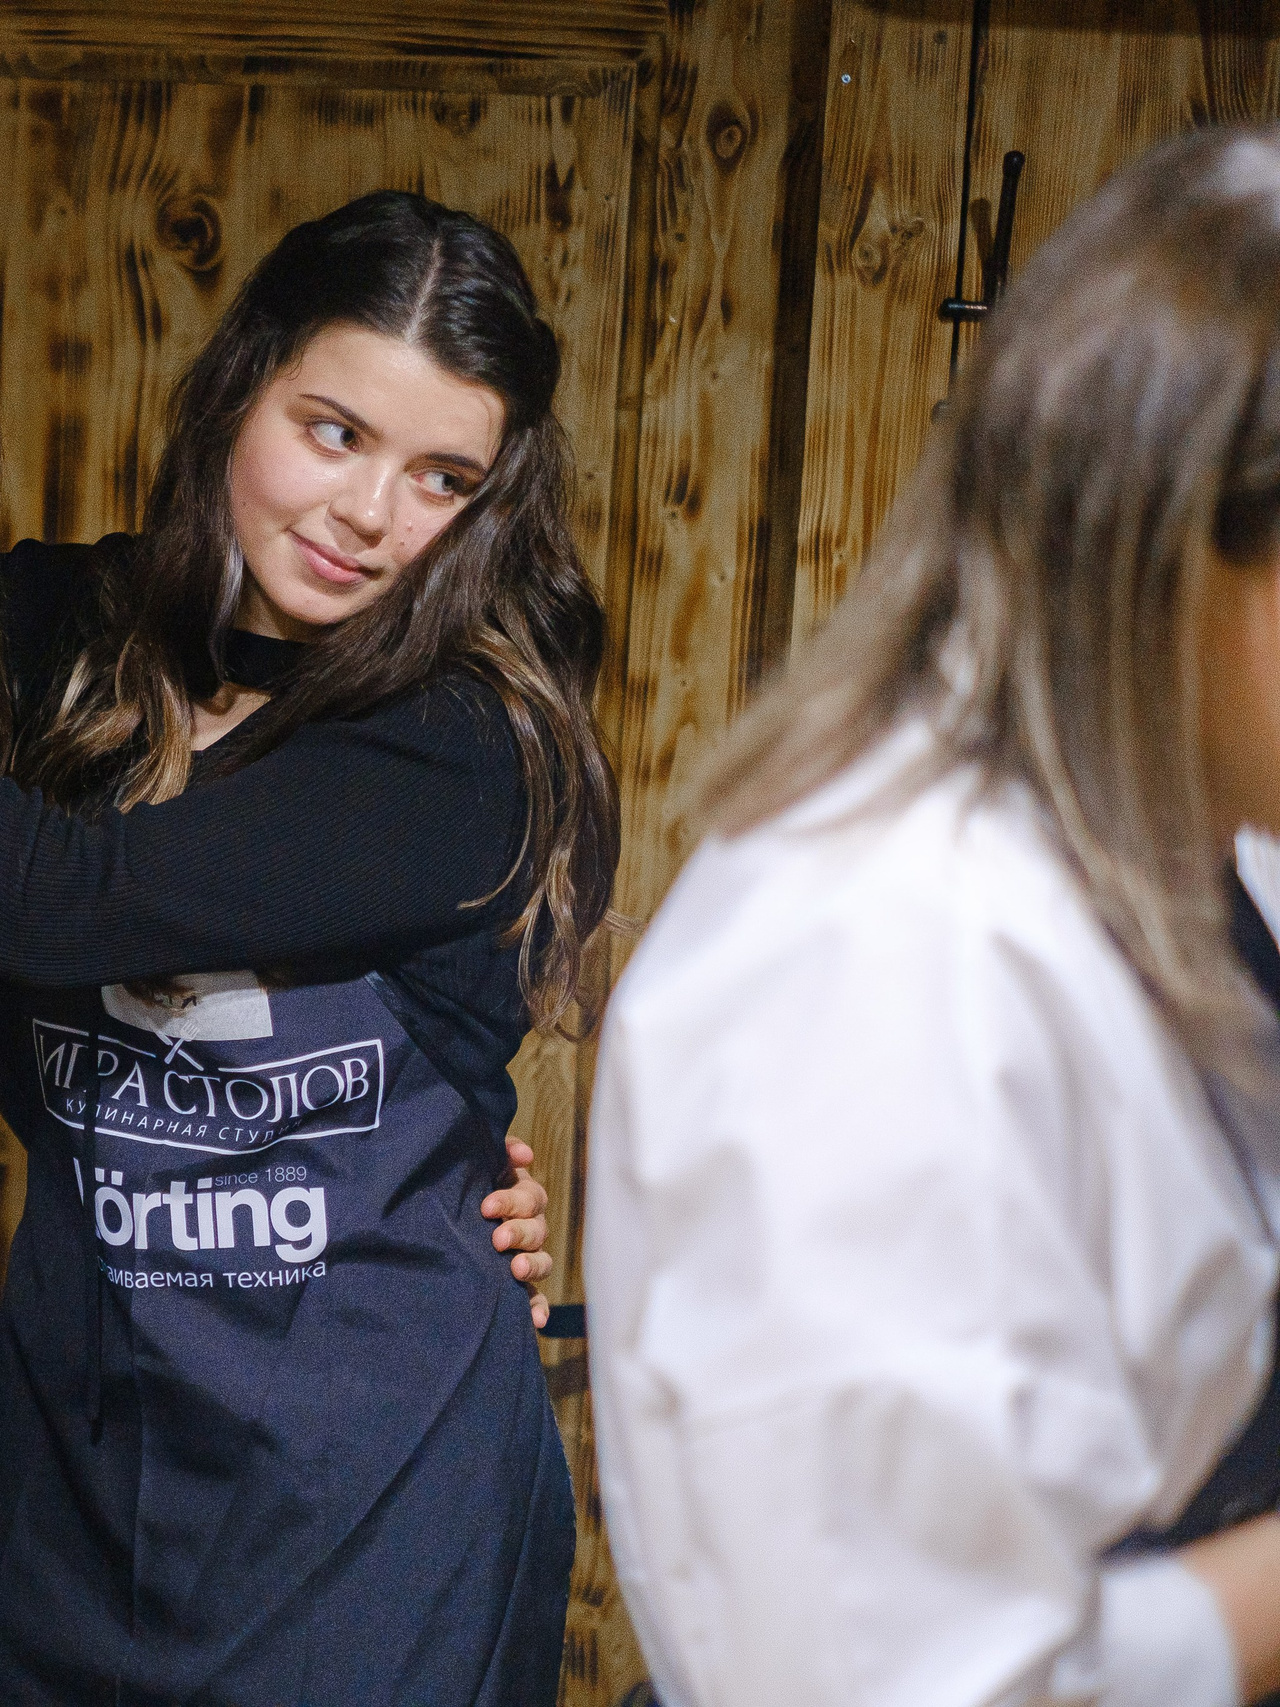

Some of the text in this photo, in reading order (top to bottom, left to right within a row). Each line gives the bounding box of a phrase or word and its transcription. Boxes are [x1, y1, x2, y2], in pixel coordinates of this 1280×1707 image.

[163, 1058, 369, 1123] СТОЛОВ
[214, 1166, 307, 1187] since 1889
[222, 1261, 326, 1288] техника
